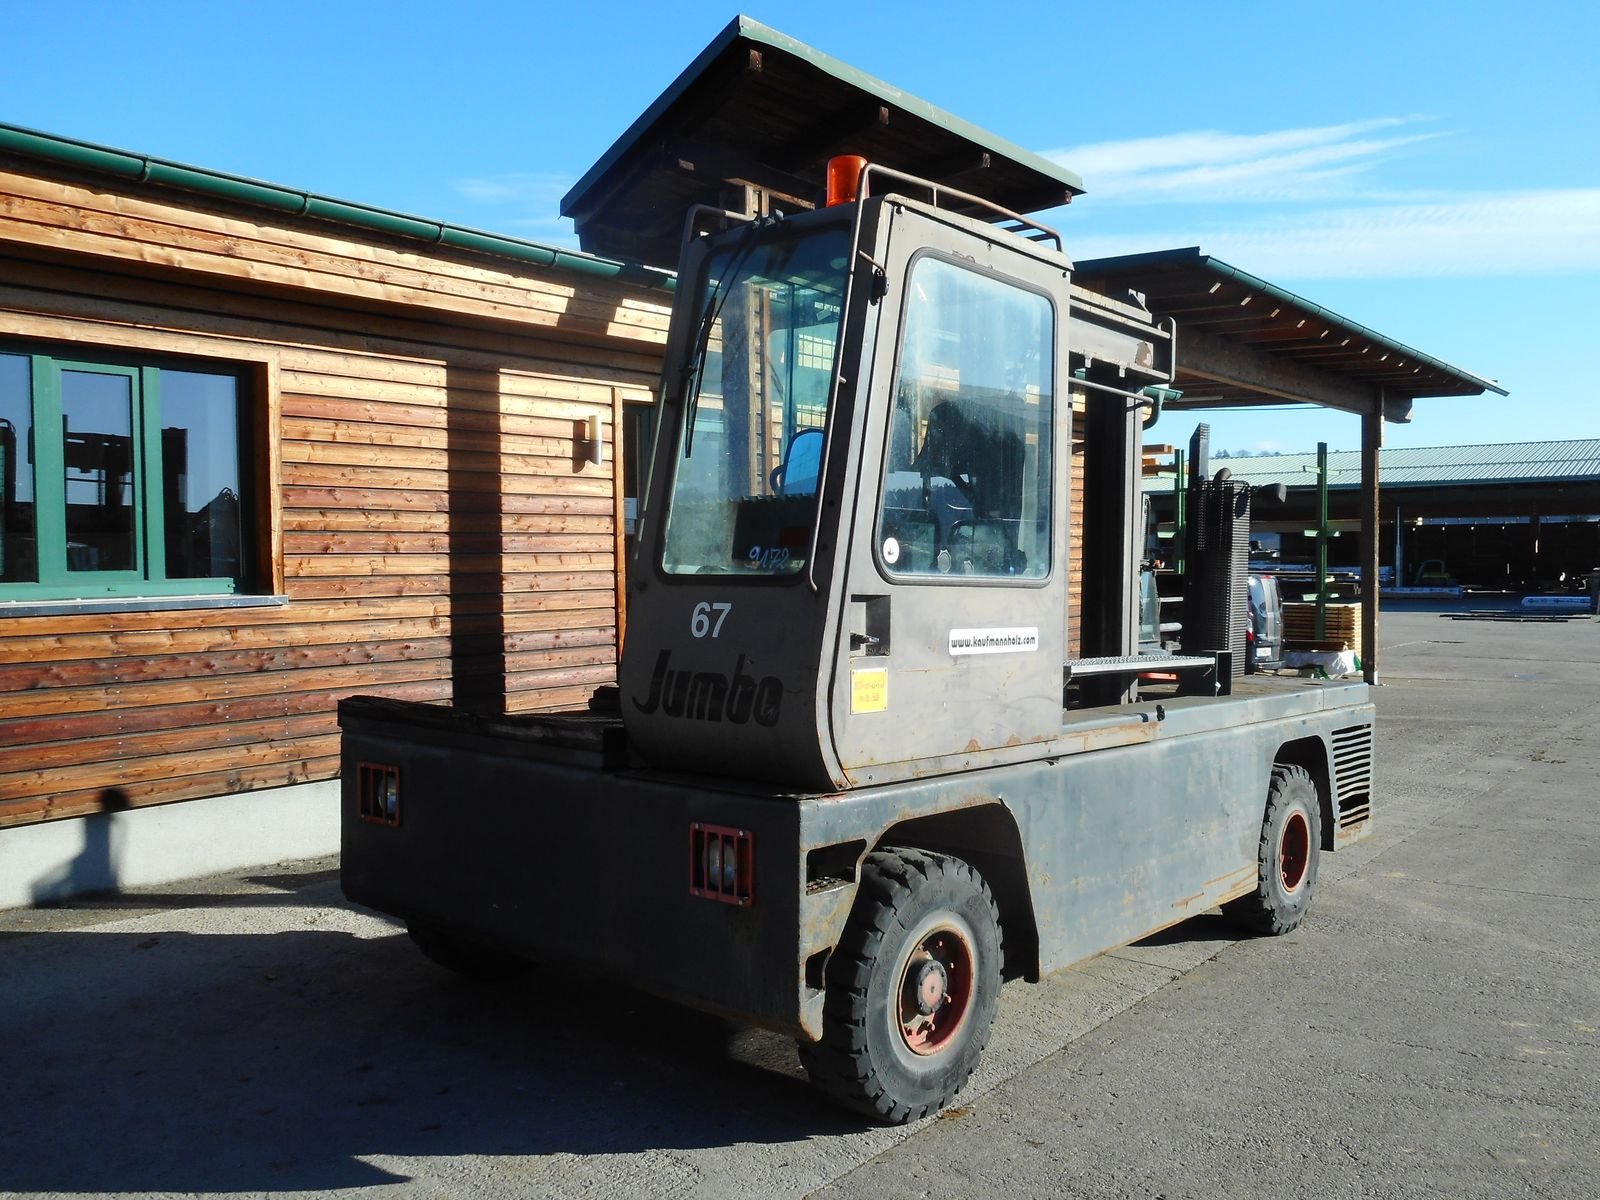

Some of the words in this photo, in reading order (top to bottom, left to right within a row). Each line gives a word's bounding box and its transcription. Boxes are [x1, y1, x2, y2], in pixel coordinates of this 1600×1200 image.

[691, 602, 732, 638] 67
[950, 634, 1036, 648] www.kaufmannholz.com
[632, 649, 783, 727] Jumbo
